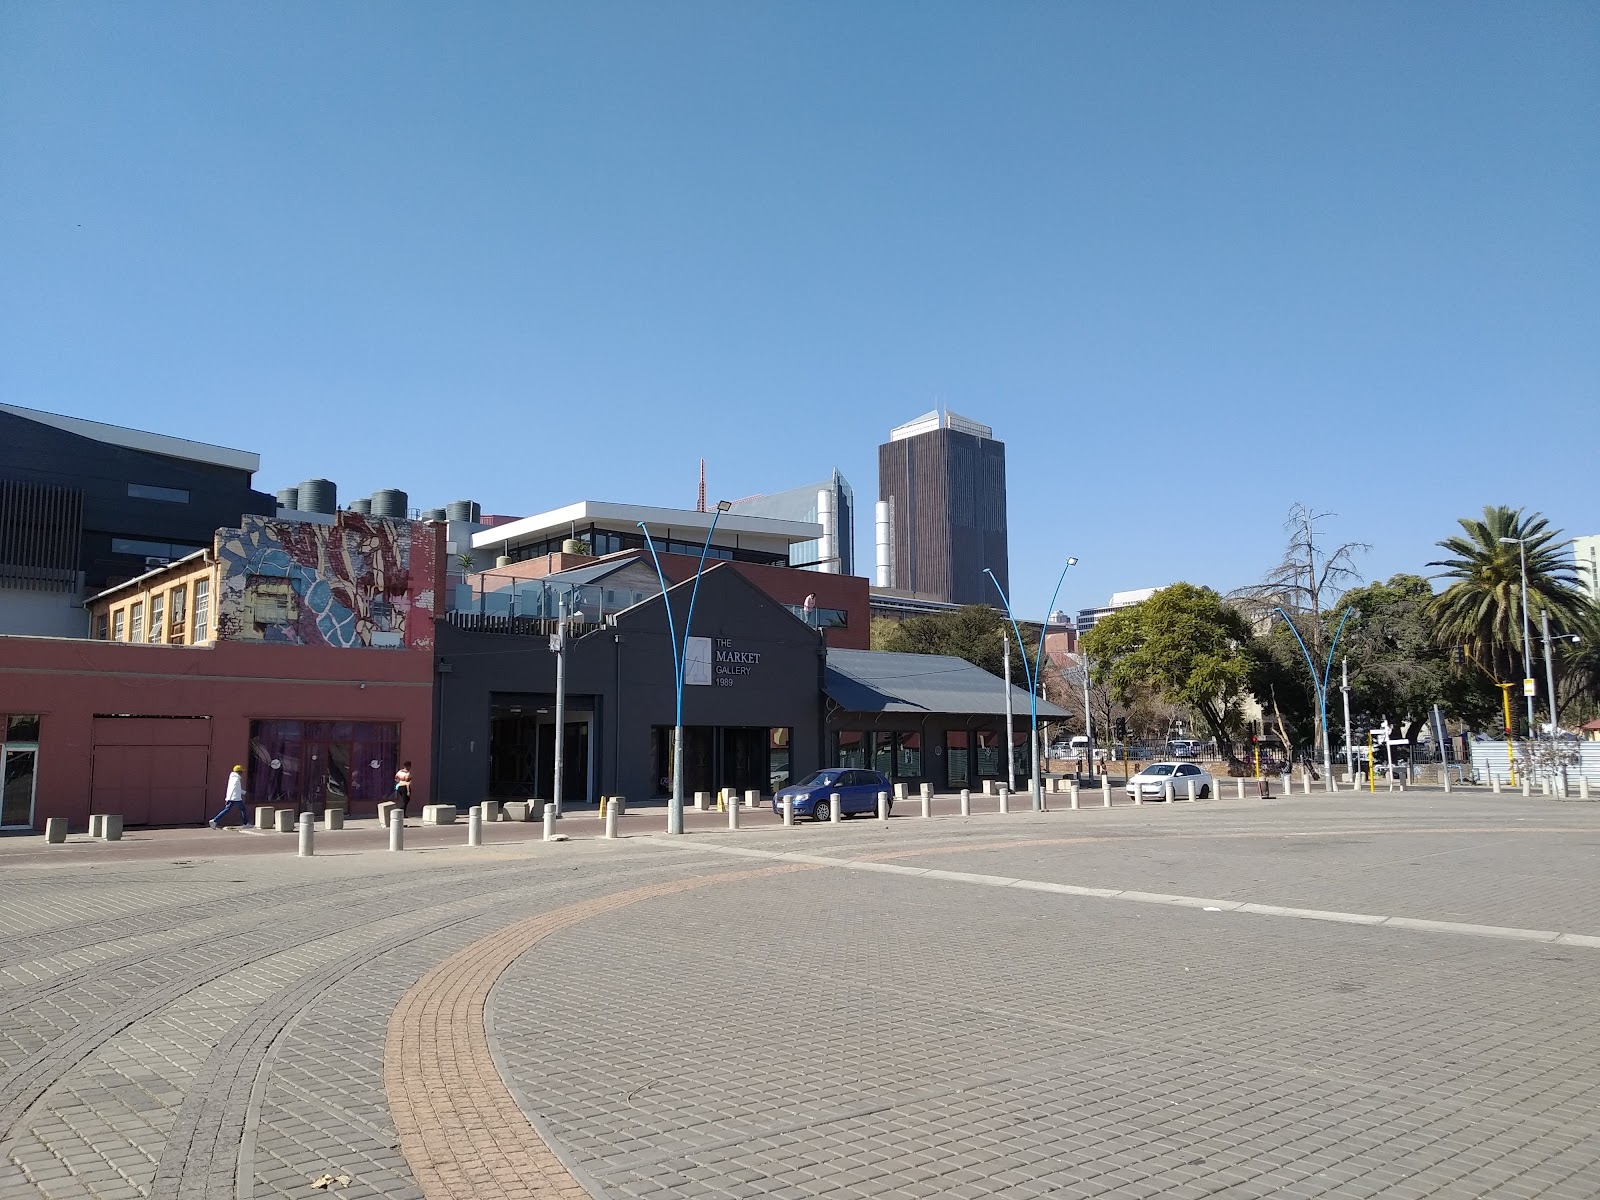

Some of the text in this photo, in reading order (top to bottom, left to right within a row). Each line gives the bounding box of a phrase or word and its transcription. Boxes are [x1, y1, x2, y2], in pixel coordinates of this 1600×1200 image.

[716, 638, 732, 648] THE
[716, 651, 760, 664] MARKET
[716, 666, 751, 675] GALLERY
[716, 678, 733, 686] 1989
